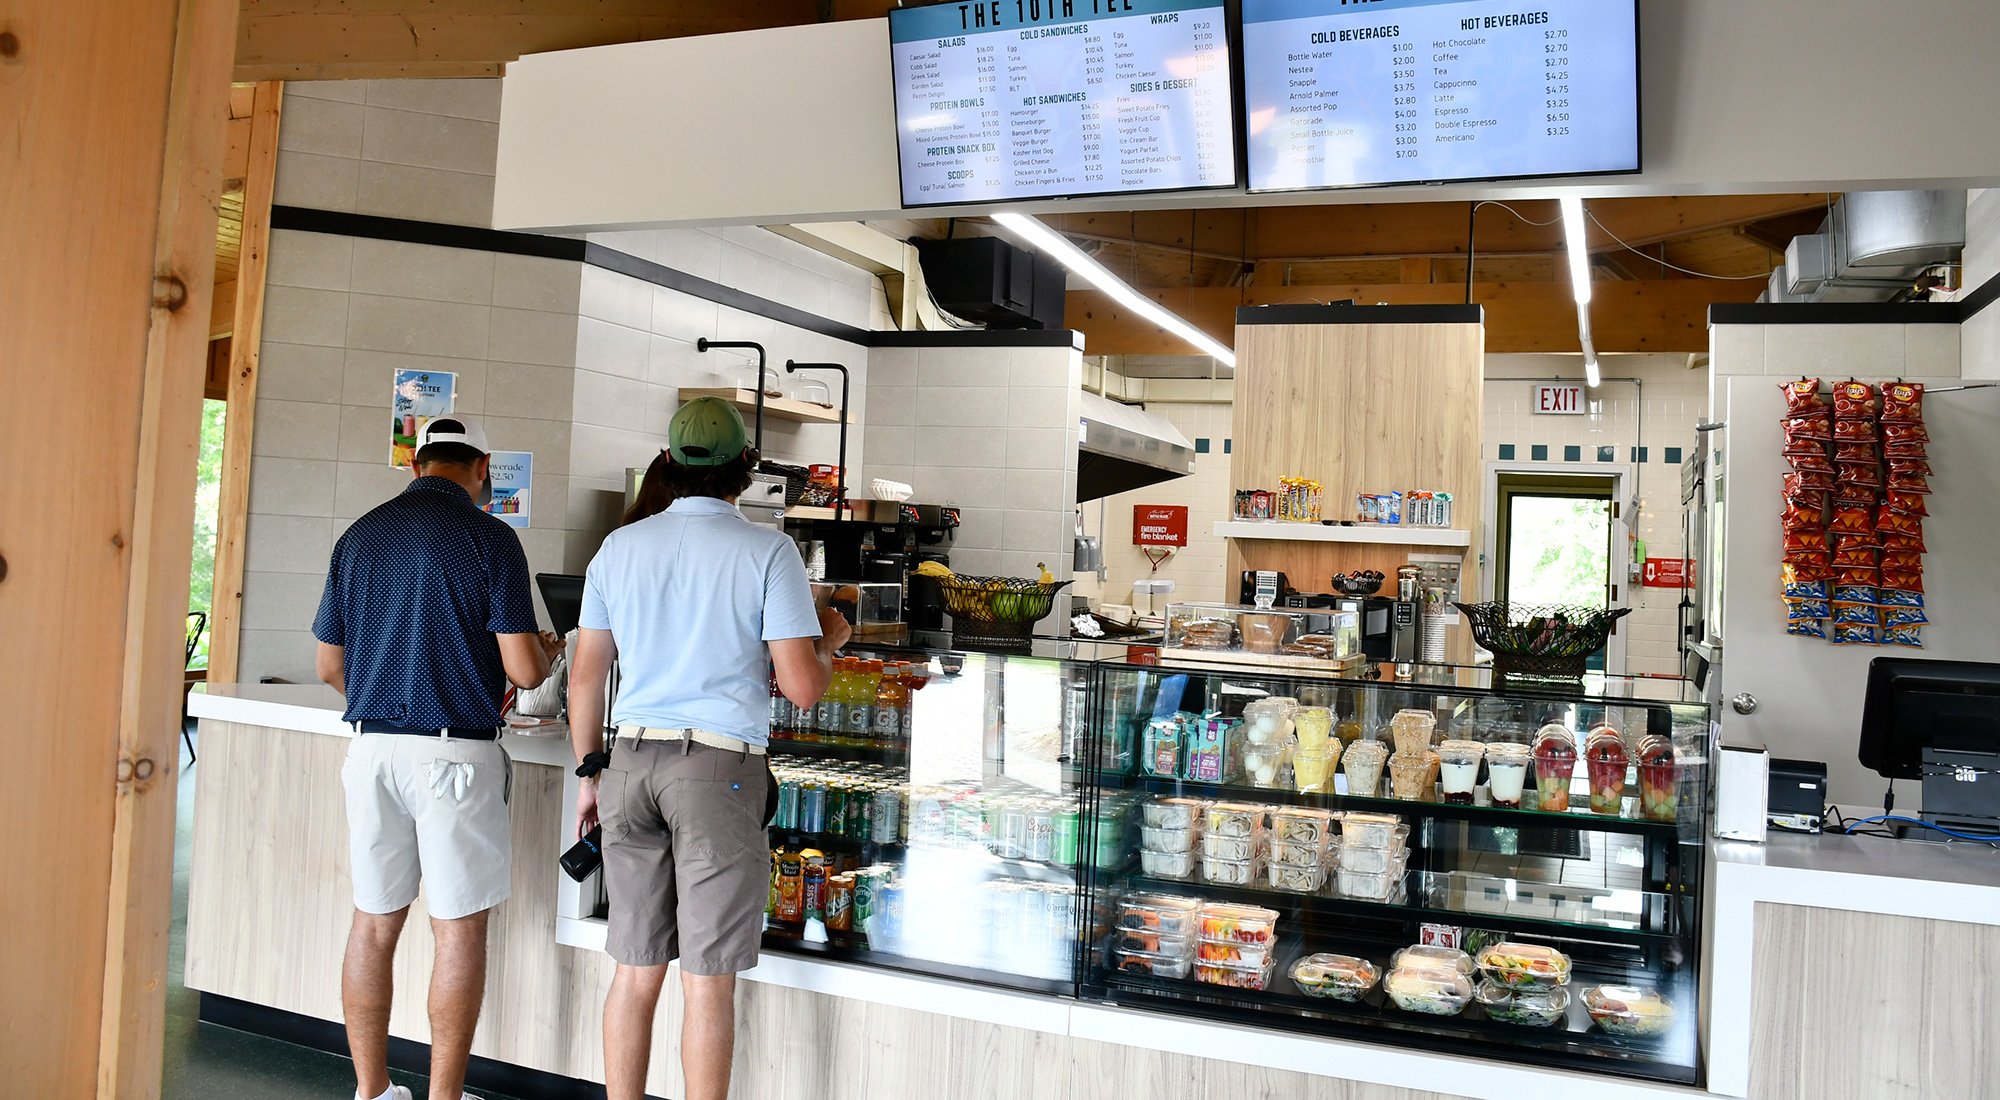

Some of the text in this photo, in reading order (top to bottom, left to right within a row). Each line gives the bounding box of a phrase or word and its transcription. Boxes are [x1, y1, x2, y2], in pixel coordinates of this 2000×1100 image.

[959, 1, 1001, 29] THE
[1151, 13, 1179, 24] WRAPS
[1461, 11, 1548, 30] HOT BEVERAGES
[1020, 24, 1088, 40] COLD SANDWICHES
[1193, 22, 1210, 30] $9.20
[1311, 25, 1400, 44] COLD BEVERAGES
[1448, 37, 1486, 48] Chocolate
[1545, 30, 1568, 39] $2.70
[938, 37, 966, 48] SALADS
[1114, 43, 1213, 59] Salmon $11.00
[1288, 43, 1413, 61] Bottle Water $1.00
[1433, 43, 1568, 62] Coffee $2.70
[1115, 62, 1134, 70] Turkey
[1289, 56, 1415, 74] Nestea $2.00
[1545, 58, 1568, 67] $2.70
[1115, 72, 1137, 80] Chicken
[1289, 70, 1415, 88] Snapple $3.50
[1434, 71, 1569, 89] Cappucinno $4.25
[1130, 78, 1198, 92] SIDES & DESSERT
[1289, 83, 1415, 100] Arnold Palmer $3.75
[1546, 85, 1569, 95] $4.75
[930, 98, 984, 111] PROTEIN BOWLS
[1023, 92, 1086, 106] HOT SANDWICHES
[1290, 96, 1416, 113] Assorted Pop $2.80
[1395, 110, 1417, 119] $4.00
[1434, 99, 1569, 116] Espresso $3.25
[1395, 123, 1417, 132] $3.20
[1435, 113, 1569, 129] Double Espresso $6.50
[1012, 129, 1033, 137] Banquet
[1435, 127, 1569, 143] Americano $3.25
[1012, 139, 1030, 147] Veggie
[1395, 137, 1418, 145] $3.00
[927, 142, 996, 156] PROTEIN SNACK BOX
[1120, 147, 1138, 155] Yogurt
[1396, 150, 1418, 159] $7.00
[948, 170, 974, 180] SCOOPS
[1121, 167, 1148, 175] Chocolate
[1036, 178, 1055, 186] Fingers
[1122, 178, 1144, 186] Popsicle
[1541, 388, 1579, 411] EXIT
[490, 463, 523, 471] werade
[1152, 533, 1178, 541] blanket
[850, 709, 863, 724] G
[877, 710, 898, 727] G2
[806, 884, 815, 910] OASIS
